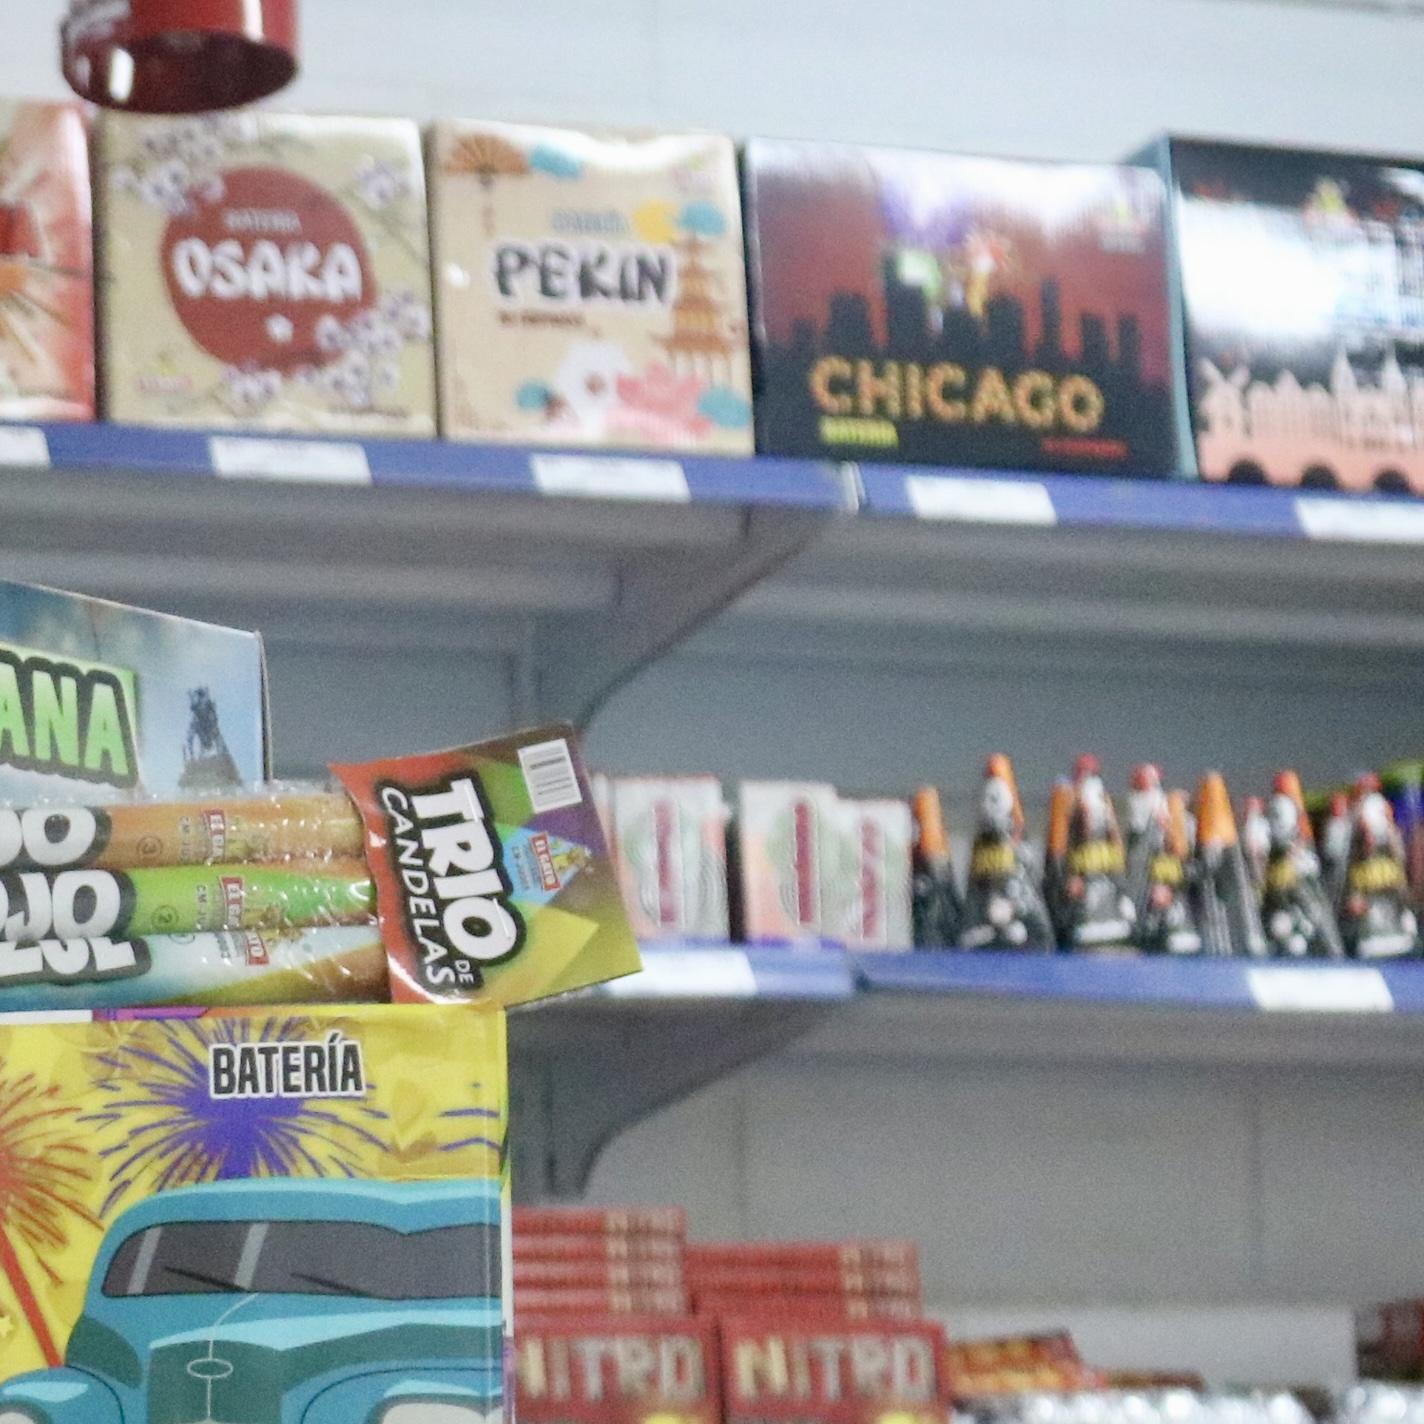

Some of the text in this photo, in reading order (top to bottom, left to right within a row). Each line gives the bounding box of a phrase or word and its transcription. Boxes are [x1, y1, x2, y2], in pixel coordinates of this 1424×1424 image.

[173, 236, 364, 303] OSAKA
[495, 243, 669, 303] PEKIN
[810, 355, 1105, 433] CHICAGO
[381, 786, 456, 986] CANDELAS
[410, 777, 517, 960] TRIO
[454, 959, 475, 984] DE
[211, 1029, 366, 1101] BATERÍA
[734, 1332, 939, 1402] NITRO
